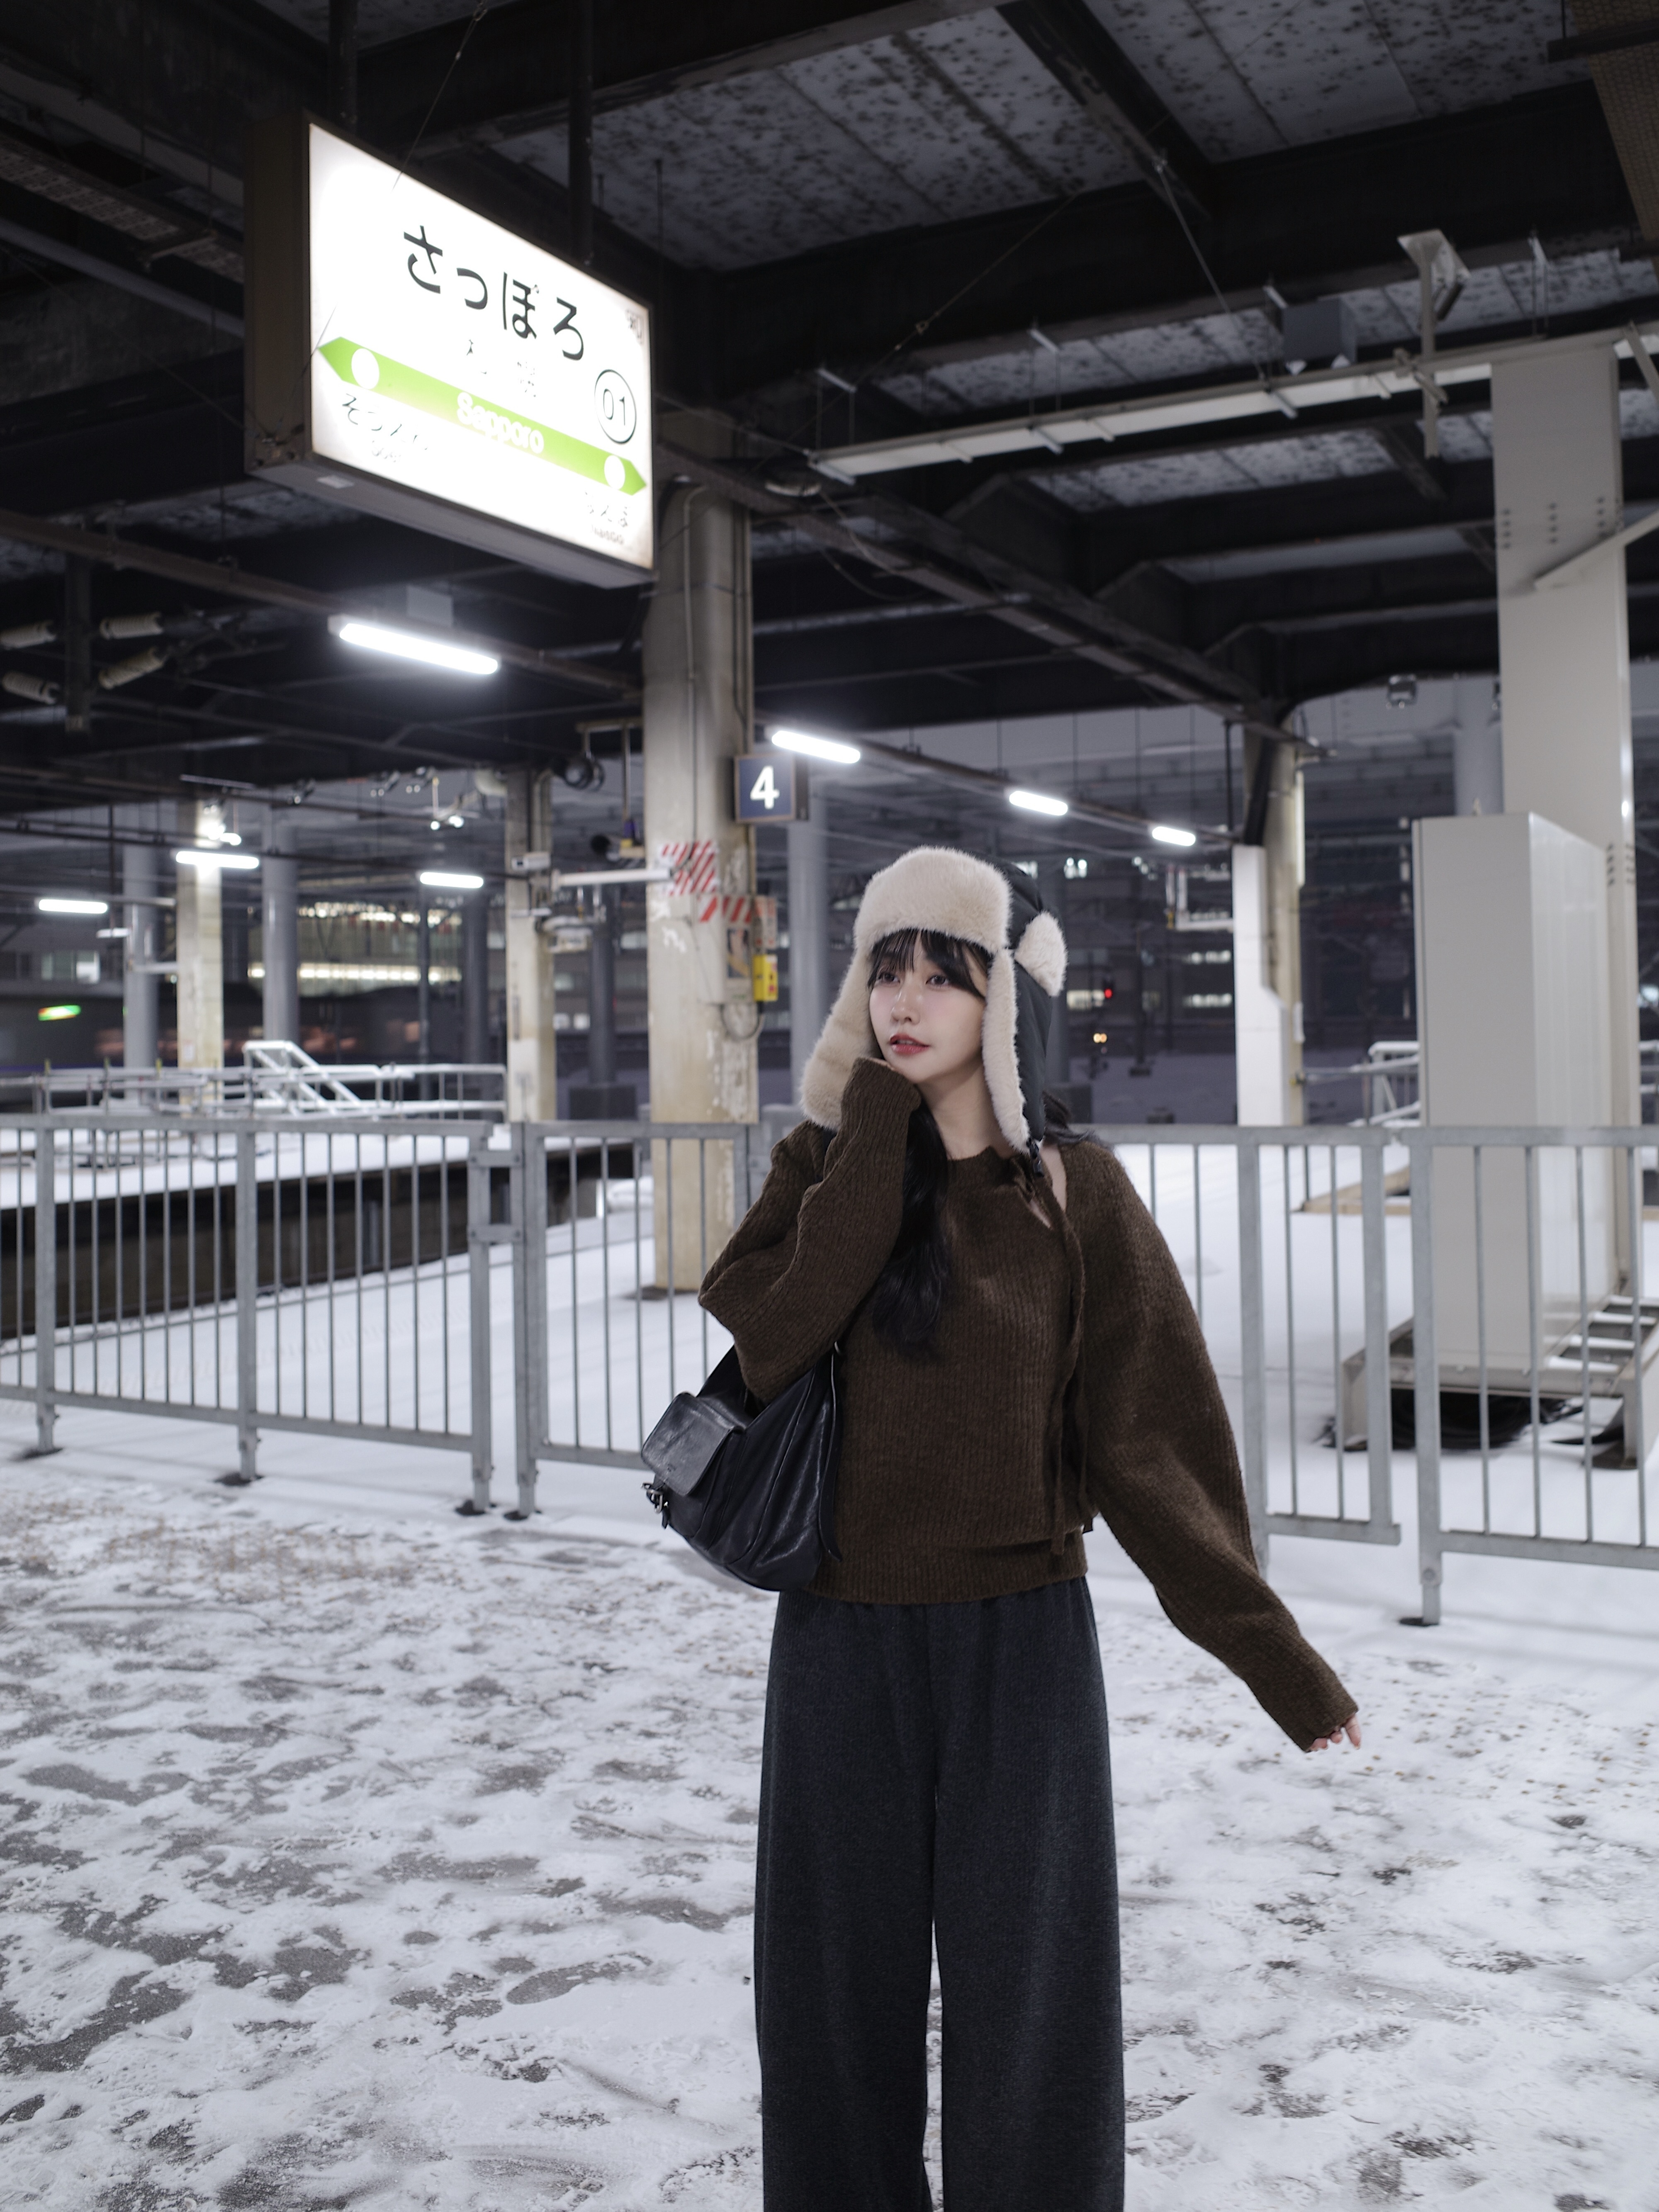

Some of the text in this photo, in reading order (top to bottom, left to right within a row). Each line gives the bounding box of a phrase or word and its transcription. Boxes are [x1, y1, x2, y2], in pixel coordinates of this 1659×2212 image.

[404, 225, 584, 360] さっぽろ
[457, 392, 545, 454] Sapporo
[603, 388, 625, 426] 01
[750, 765, 780, 809] 4
